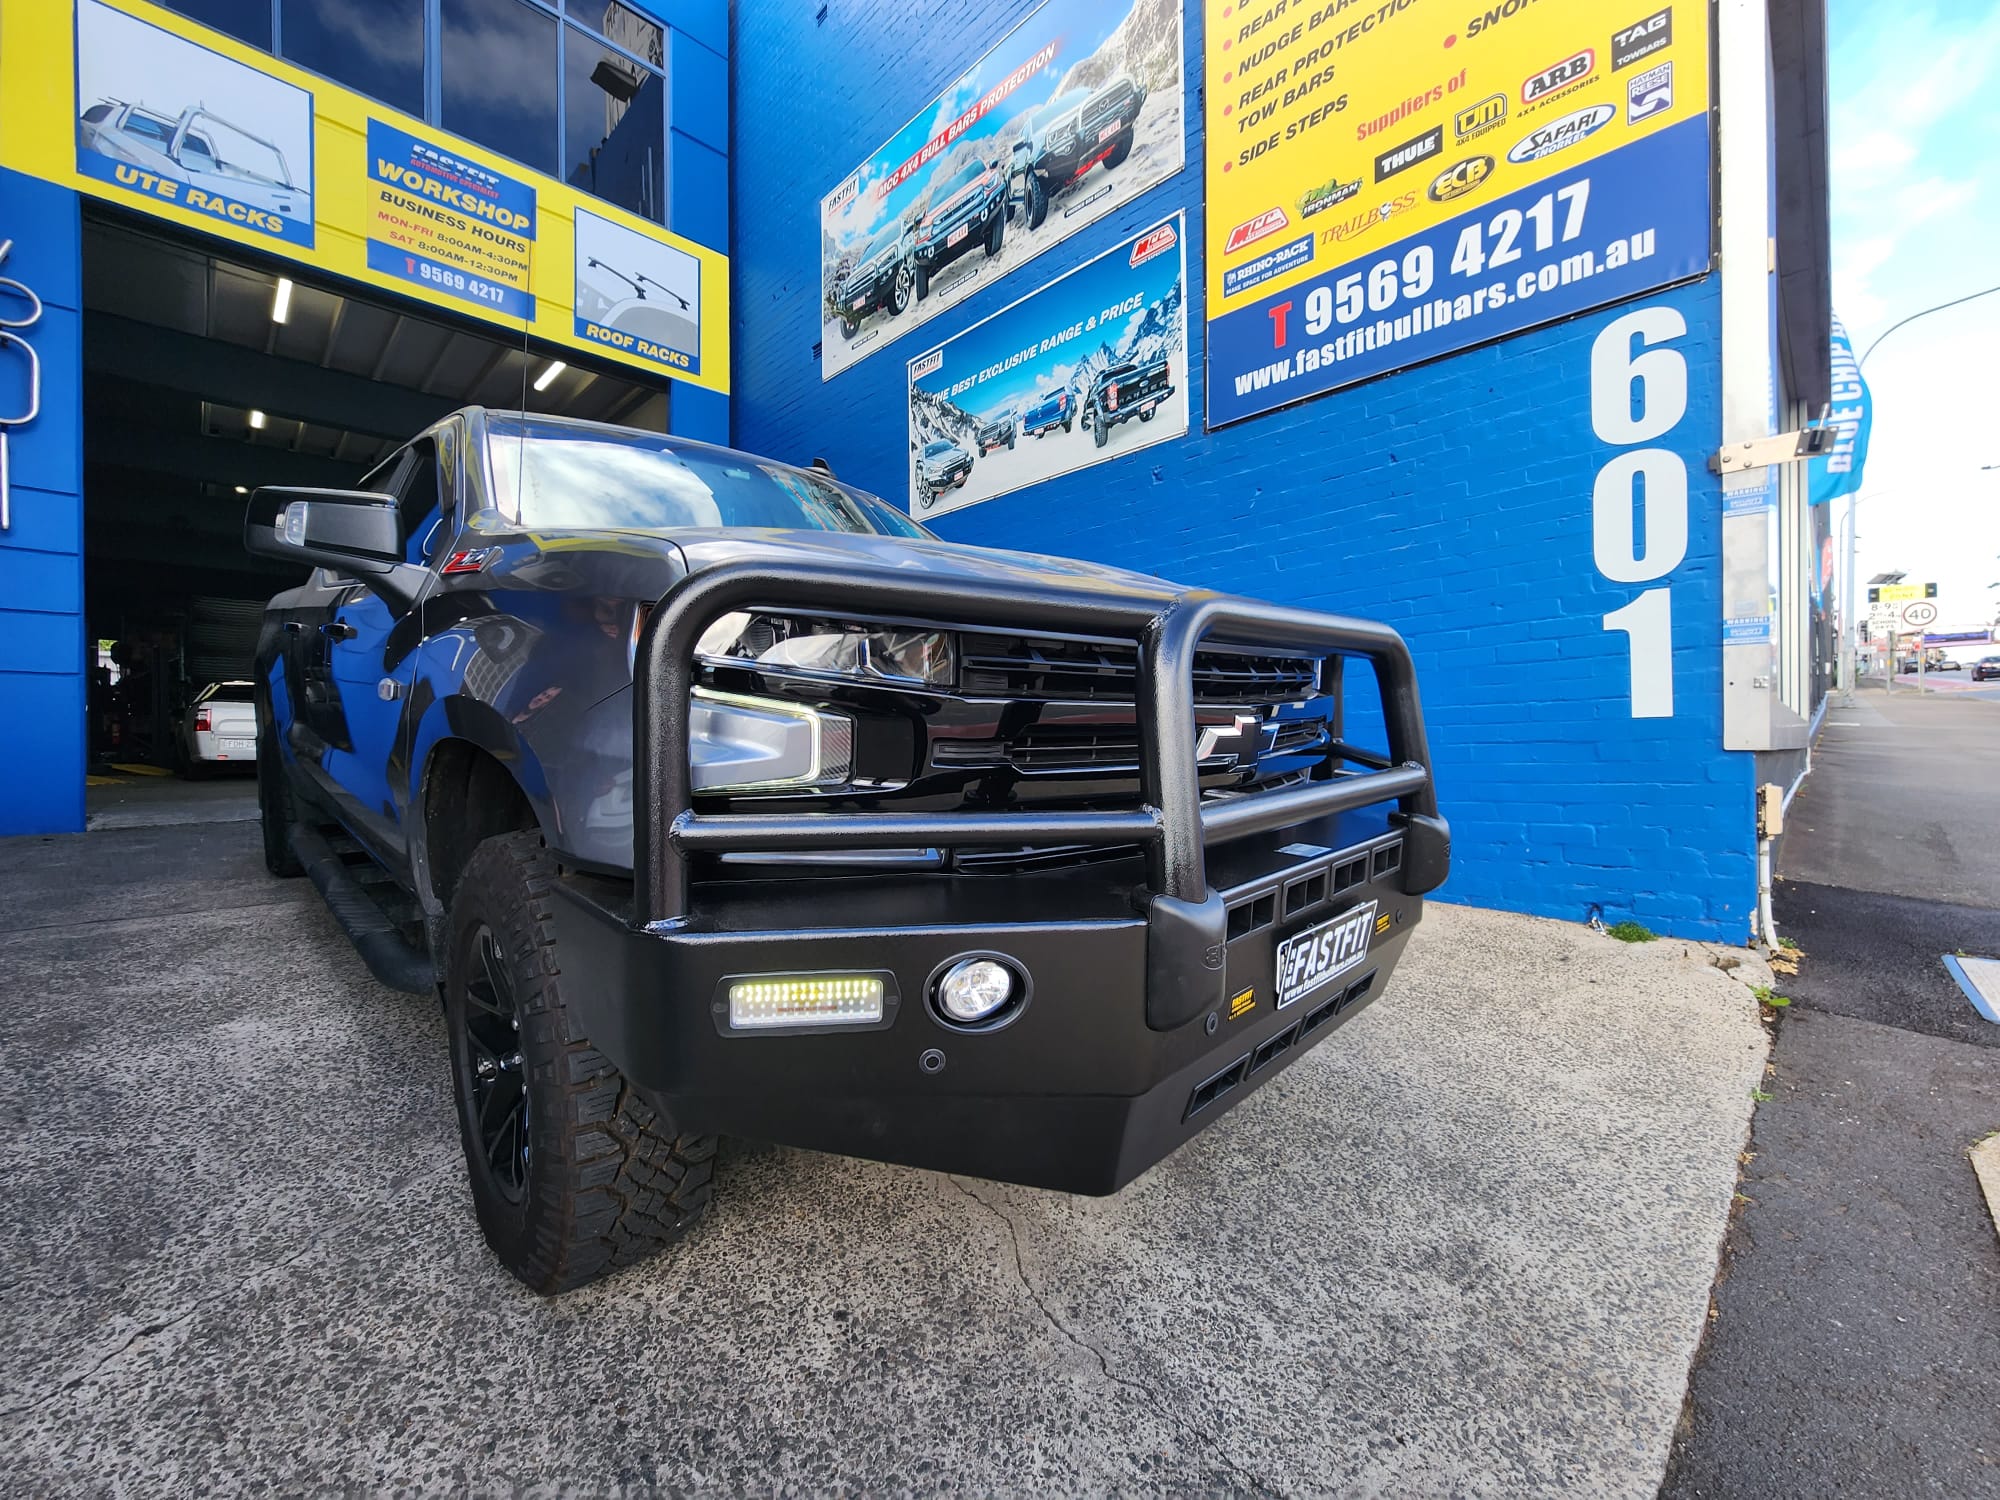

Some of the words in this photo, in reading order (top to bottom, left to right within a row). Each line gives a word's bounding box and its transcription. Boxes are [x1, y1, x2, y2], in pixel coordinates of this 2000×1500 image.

[1238, 0, 1287, 43] REAR
[1238, 22, 1303, 77] NUDGE
[1308, 0, 1358, 32] BAR
[1614, 13, 1667, 47] TAG
[1238, 68, 1288, 110] REAR
[1293, 0, 1417, 76] PROTECTIO
[1617, 36, 1667, 66] TOWBARS
[1517, 106, 1535, 119] 4X4
[1539, 74, 1600, 108] ACCESSORIES
[1528, 55, 1588, 99] ARB
[1630, 64, 1670, 86] HAYMAN
[878, 174, 899, 197] MCC
[900, 157, 918, 179] 4X4
[920, 137, 946, 163] BULL
[947, 107, 978, 141] BARS
[979, 43, 1056, 115] PROTECTION
[1238, 98, 1278, 133] TOW
[1282, 65, 1335, 108] BARS
[1357, 85, 1443, 141] Suppliers
[1448, 68, 1466, 93] of
[1239, 131, 1281, 167] SIDE
[1285, 93, 1348, 140] STEPS
[1456, 135, 1470, 147] 4X4
[1472, 118, 1506, 142] EQUIPPED
[1522, 109, 1599, 156] SAFARI
[1534, 130, 1588, 160] SNORKEL
[411, 144, 500, 190] FASTFIT
[1382, 136, 1436, 174] THULE
[1436, 157, 1488, 196] ECB
[115, 164, 178, 199] UTE
[186, 188, 284, 233] RACKS
[377, 158, 530, 231] WORKSHOP
[828, 180, 857, 212] FASTFIT
[1303, 182, 1358, 214] IRONMAN
[378, 211, 433, 238] MON-FRI
[437, 233, 528, 271] 8:00AM-4:30PM
[380, 190, 467, 231] BUSINESS
[471, 225, 525, 253] HOURS
[389, 231, 414, 246] SAT
[418, 241, 518, 282] 8:00AM-12:30PM
[1226, 283, 1241, 295] MAKE
[1261, 270, 1272, 280] FOR
[1274, 254, 1309, 275] ADVENTURE
[1237, 239, 1309, 280] RHINO-RACK
[1268, 301, 1292, 349] T
[1304, 244, 1434, 336] 9569
[1450, 178, 1591, 278] 4217
[404, 257, 416, 274] T
[420, 262, 464, 290] 9569
[468, 279, 504, 303] 4217
[1234, 228, 1656, 396] www.fastfitbullbars.com.au
[586, 323, 634, 347] ROOF
[637, 340, 689, 367] RACKS
[913, 353, 940, 375] FASTFIT
[932, 387, 950, 405] THE
[951, 374, 978, 397] BEST
[978, 343, 1039, 383] EXCLUSIVE
[1039, 322, 1083, 354] RANGE
[1085, 315, 1097, 332] &
[1100, 291, 1145, 325] PRICE
[1826, 405, 1863, 474] BLUE
[1591, 306, 1688, 718] 601
[1908, 608, 1931, 620] 40
[1291, 911, 1373, 986] FASTFIT
